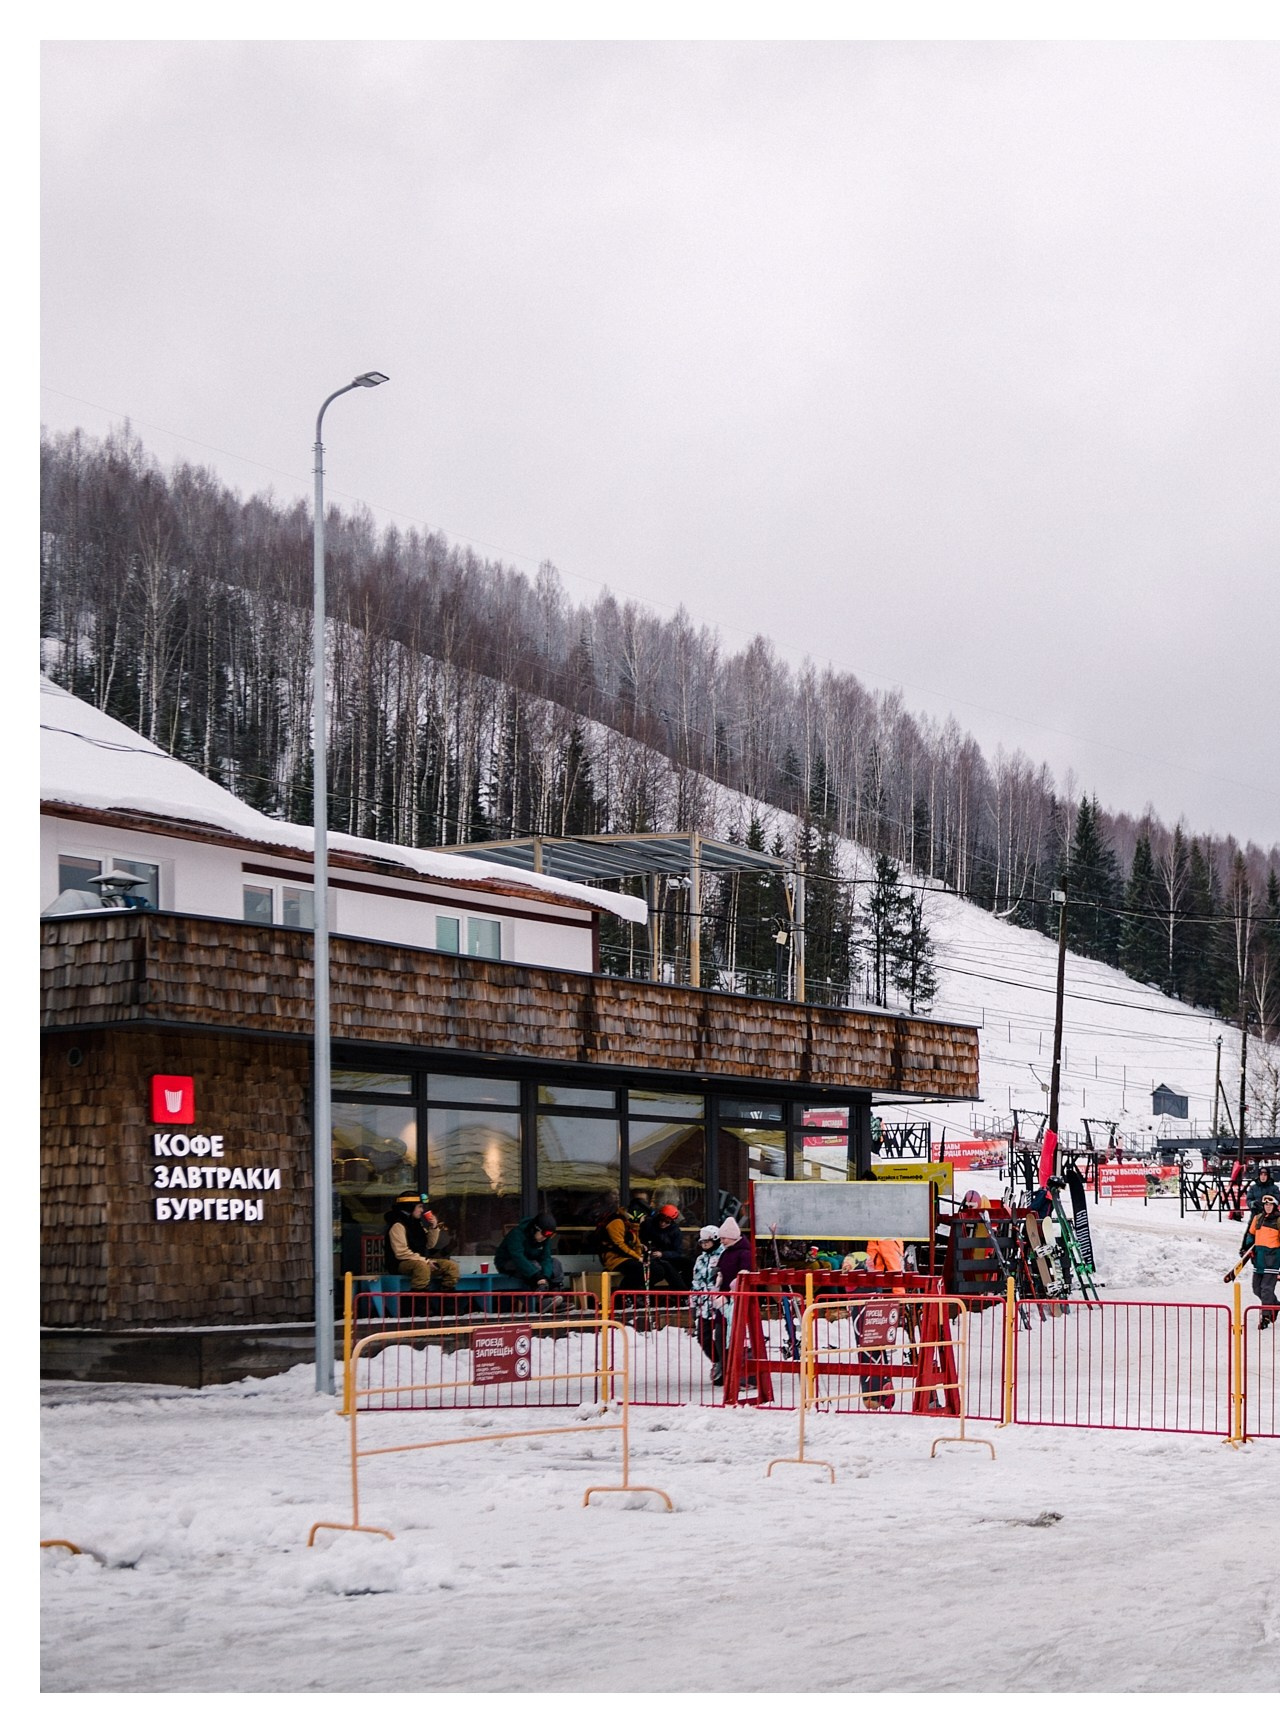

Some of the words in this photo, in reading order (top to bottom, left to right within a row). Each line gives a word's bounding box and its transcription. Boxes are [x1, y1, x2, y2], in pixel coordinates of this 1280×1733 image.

[154, 1133, 224, 1157] КОФЕ
[154, 1165, 281, 1189] ЗАВТРАКИ
[1120, 1168, 1161, 1176] ВЫХОДНОГО
[156, 1198, 264, 1221] БУРГЕРЫ
[475, 1337, 503, 1348] ПРОЕЗД
